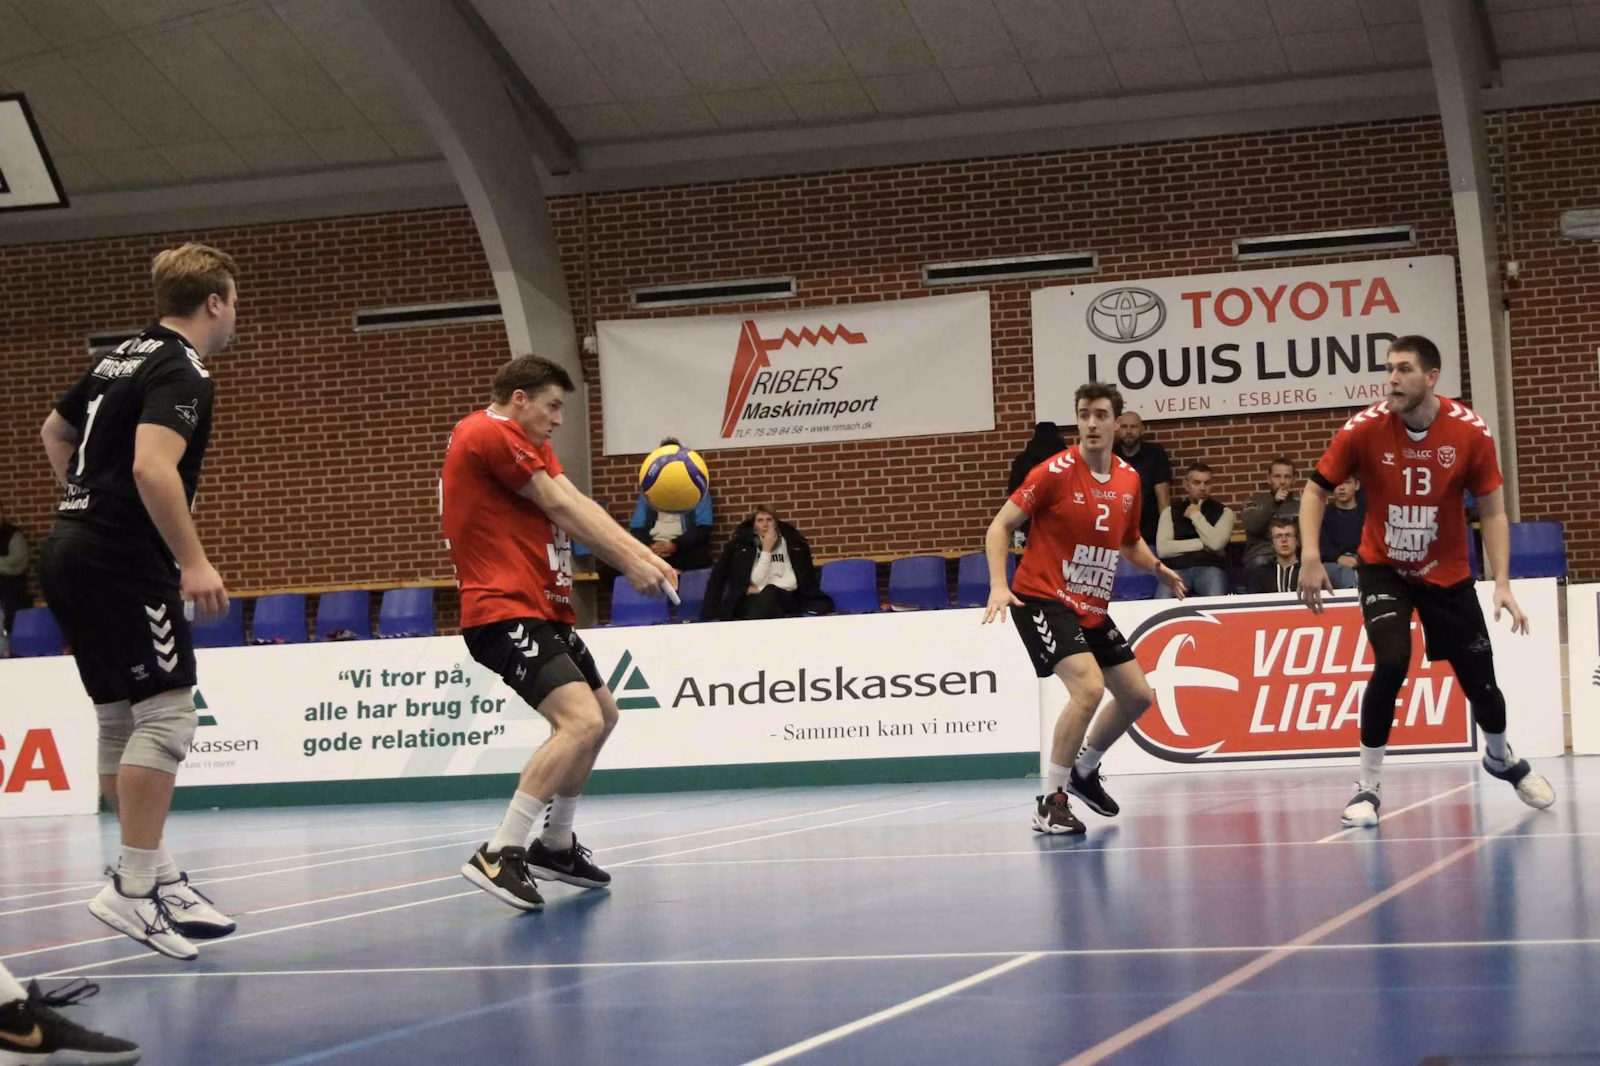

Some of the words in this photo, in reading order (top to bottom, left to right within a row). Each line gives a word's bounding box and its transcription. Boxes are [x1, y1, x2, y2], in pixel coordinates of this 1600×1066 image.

[1181, 277, 1400, 329] TOYOTA
[1087, 343, 1242, 391] LOUIS
[1256, 332, 1399, 380] LUND
[752, 366, 843, 396] RIBERS
[742, 395, 878, 420] Maskinimport
[1155, 396, 1211, 413] VEJEN
[1238, 388, 1317, 408] ESBJERG
[1417, 449, 1432, 458] LCC
[1402, 466, 1431, 495] 13
[1104, 490, 1118, 499] LCC
[1095, 503, 1110, 531] 2
[1388, 504, 1438, 529] BLUE
[1072, 544, 1120, 571] BLUE
[1062, 559, 1116, 592] WATE
[1066, 582, 1112, 601] SHIPPING
[1253, 621, 1432, 677] VOLL
[381, 669, 426, 687] tror
[435, 663, 471, 688] på,
[672, 666, 997, 708] Andelskassen
[304, 702, 347, 721] alle
[357, 700, 397, 719] har
[406, 698, 461, 719] brug
[470, 695, 506, 714] for
[303, 732, 362, 757] gode
[372, 725, 505, 749] relationer”
[783, 722, 870, 741] Sammen
[877, 720, 914, 737] kan
[921, 718, 938, 735] vi
[945, 718, 998, 734] mere
